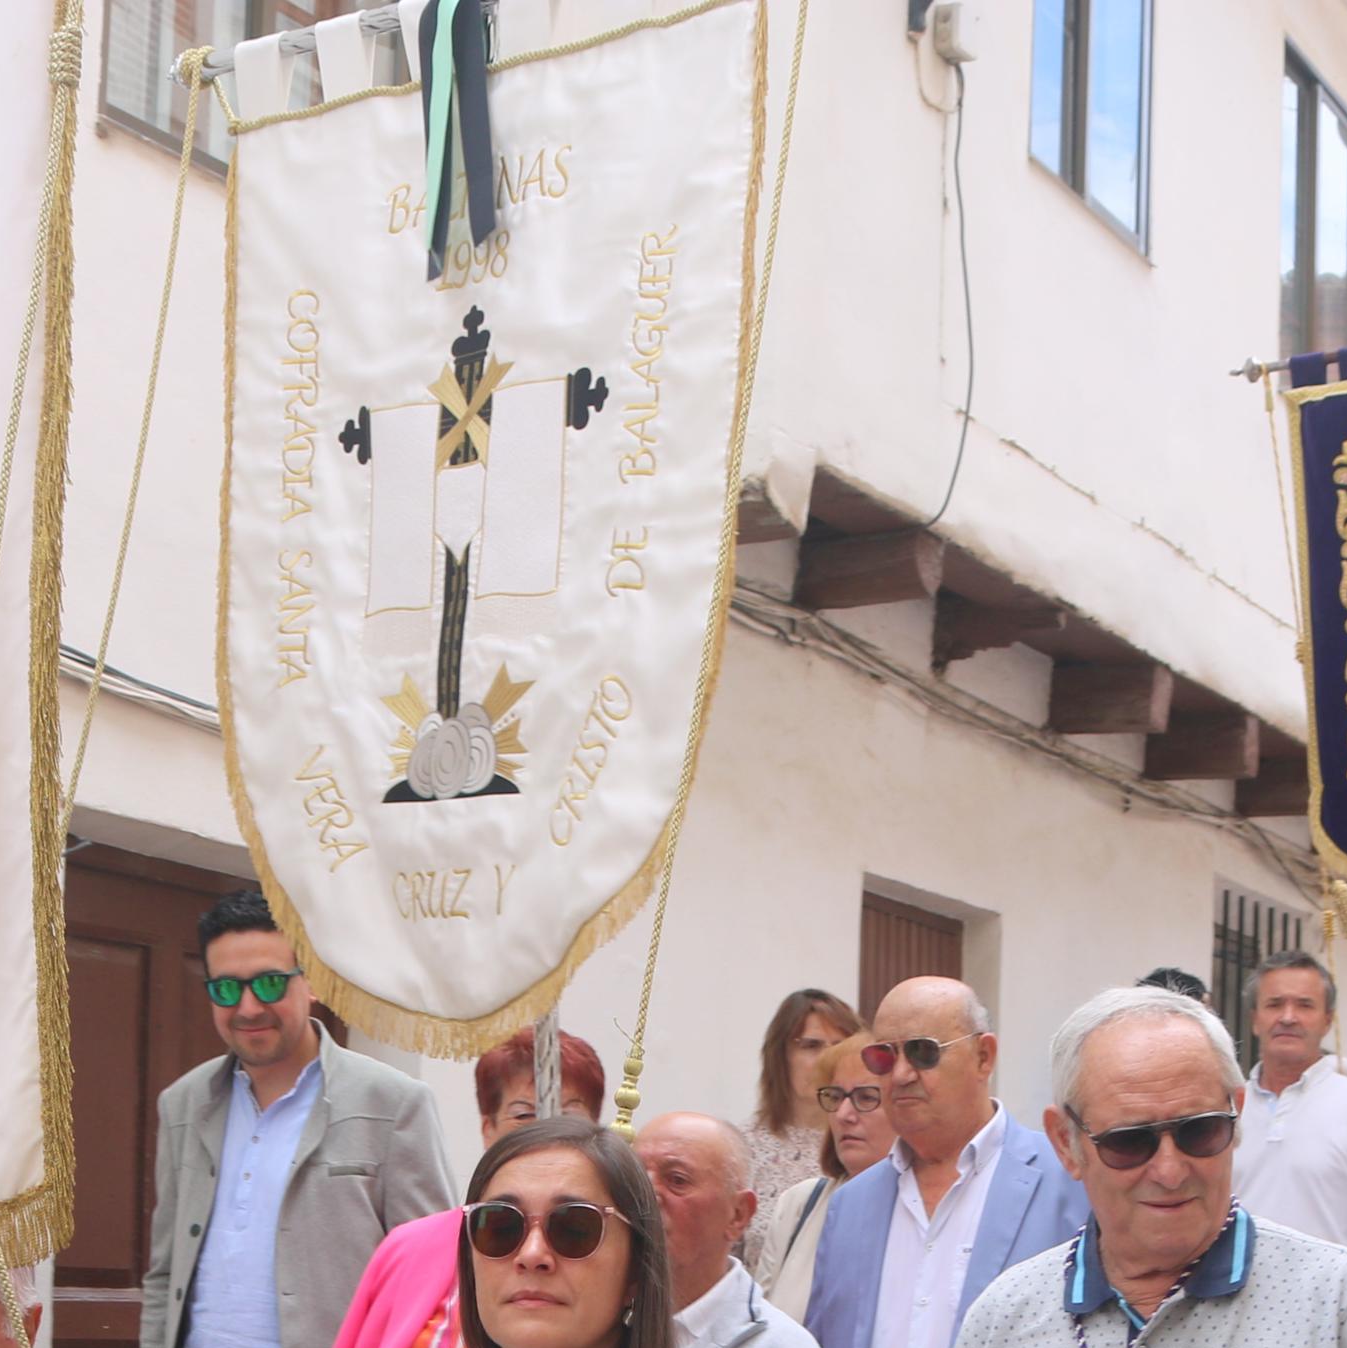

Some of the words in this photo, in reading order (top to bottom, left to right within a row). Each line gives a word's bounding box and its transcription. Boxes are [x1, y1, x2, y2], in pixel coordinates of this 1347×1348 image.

[280, 288, 320, 525] COFRADIA
[618, 221, 679, 485] BALAGUER
[277, 548, 314, 689] SANTA
[605, 526, 649, 598] DE
[293, 745, 369, 873] VERA
[549, 674, 633, 848] CRISTO
[392, 869, 472, 921] CRUZ
[493, 863, 517, 916] Y
